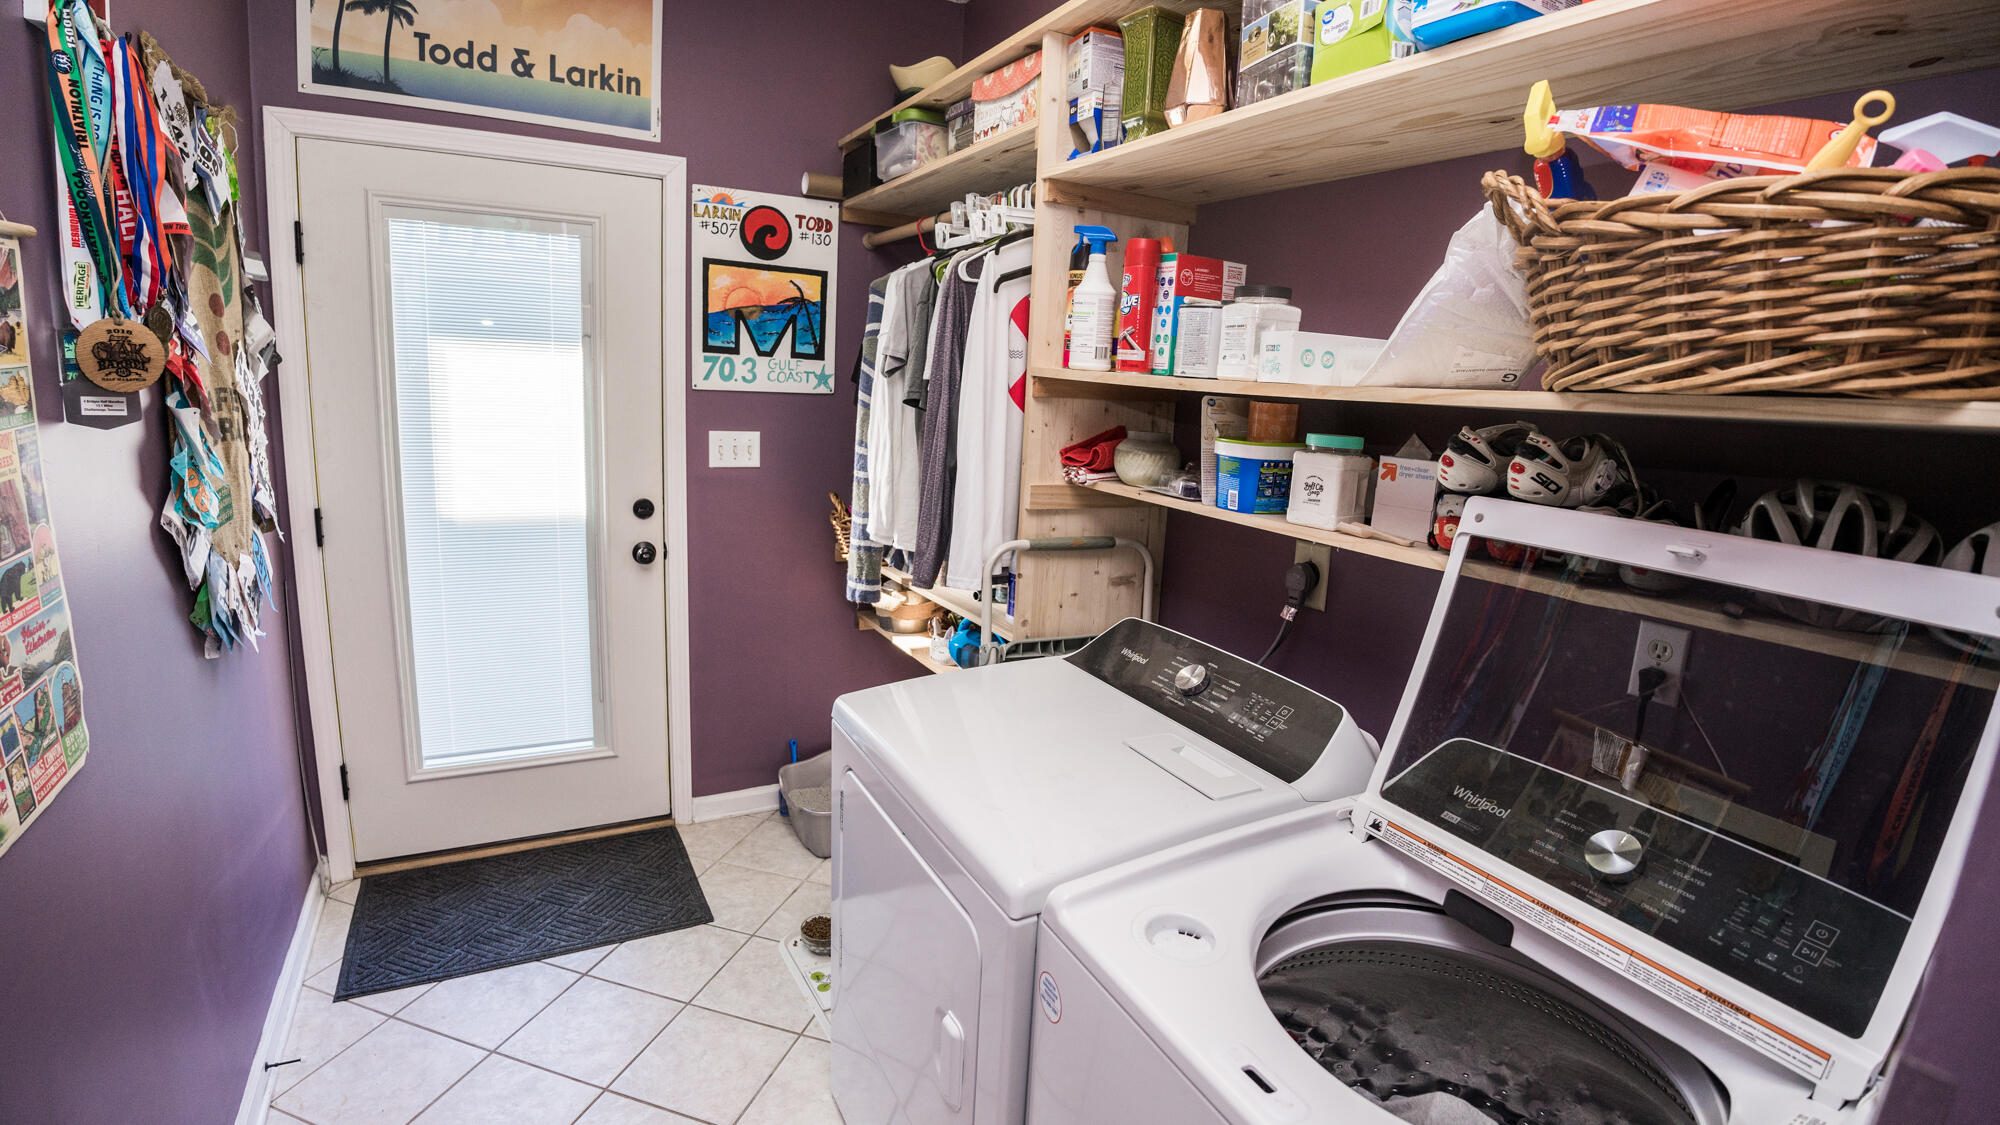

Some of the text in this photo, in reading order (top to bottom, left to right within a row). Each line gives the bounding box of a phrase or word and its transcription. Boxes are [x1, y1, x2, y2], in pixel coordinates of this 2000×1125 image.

[62, 8, 76, 49] 1500M
[413, 32, 642, 97] Todd & Larkin
[68, 78, 102, 267] CHATTANOOGA TRIATHLON
[693, 203, 742, 222] LARKIN
[699, 221, 738, 238] #507
[795, 214, 834, 233] TODD
[799, 231, 832, 247] #130
[76, 263, 86, 308] HERITAGE
[703, 355, 758, 384] 70.3
[767, 357, 803, 371] GULF
[767, 370, 815, 384] COAST
[1120, 647, 1149, 665] Whirlpool
[1453, 785, 1512, 819] Whirlpool
